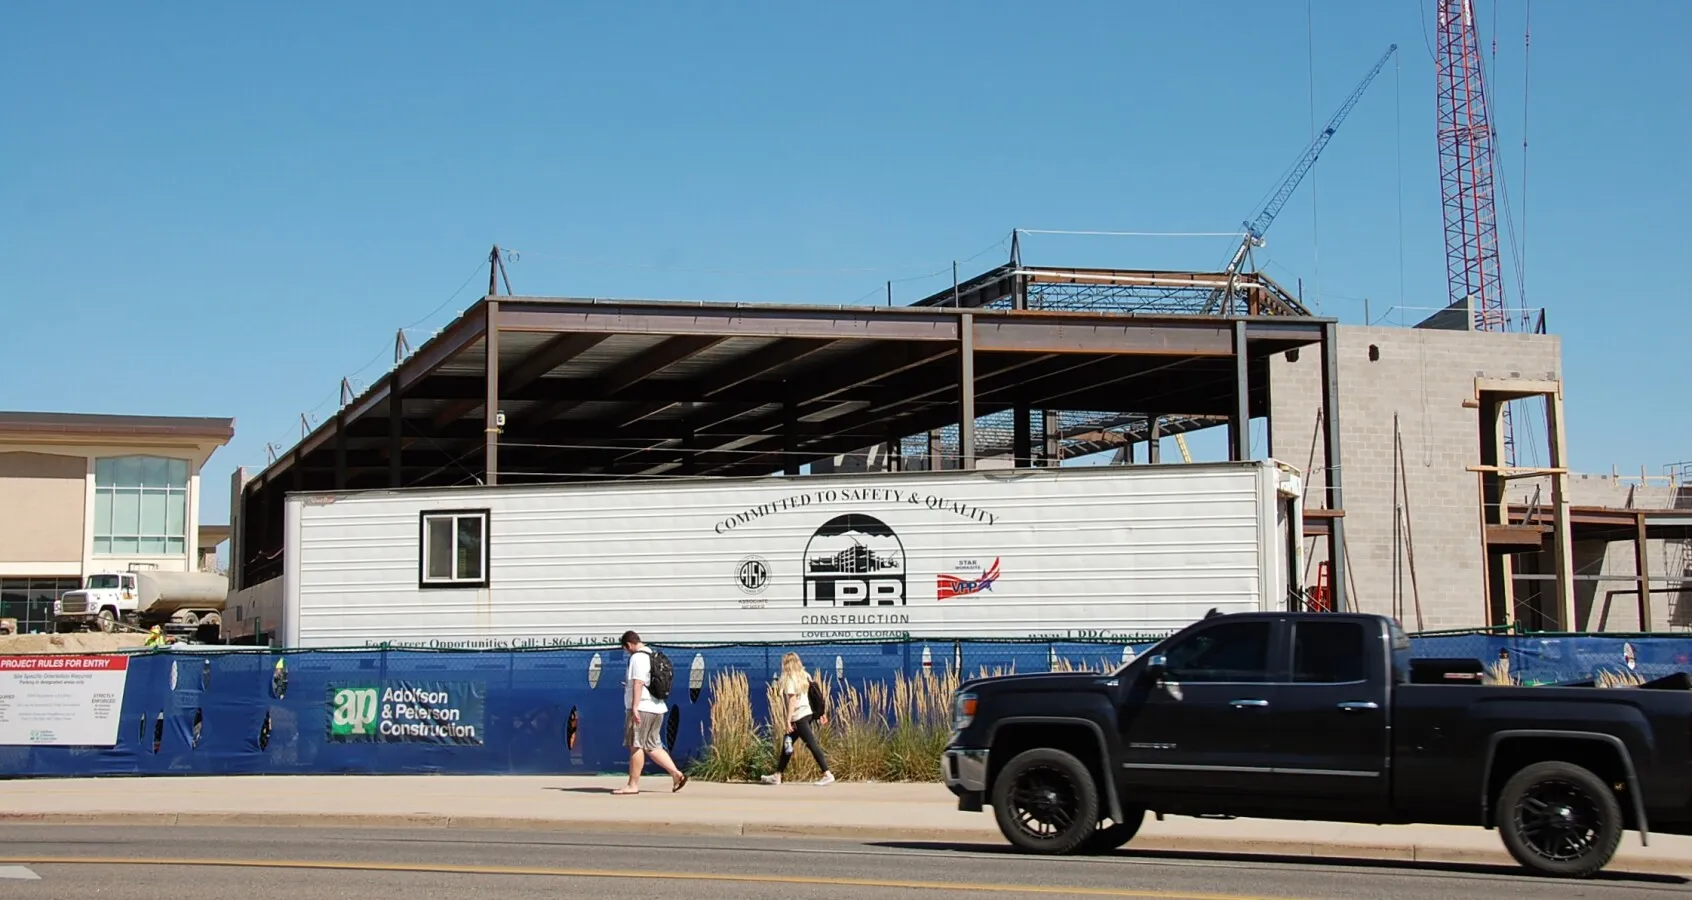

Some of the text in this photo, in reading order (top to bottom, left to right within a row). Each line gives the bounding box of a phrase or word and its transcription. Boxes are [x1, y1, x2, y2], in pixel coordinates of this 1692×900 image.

[714, 488, 1000, 535] COMMITTED TO SAFETY & QUALITY
[806, 579, 903, 607] LPR
[951, 581, 978, 593] VPP
[801, 614, 909, 625] CONSTRUCTION
[801, 630, 853, 639] LOVELAND,
[429, 637, 508, 650] Opportunities
[511, 636, 539, 649] Call:
[0, 659, 110, 668] PROJECT RULES FOR ENTRY
[382, 687, 448, 704] Adolfson
[381, 704, 460, 721] & Peterson
[380, 721, 475, 738] Construction
